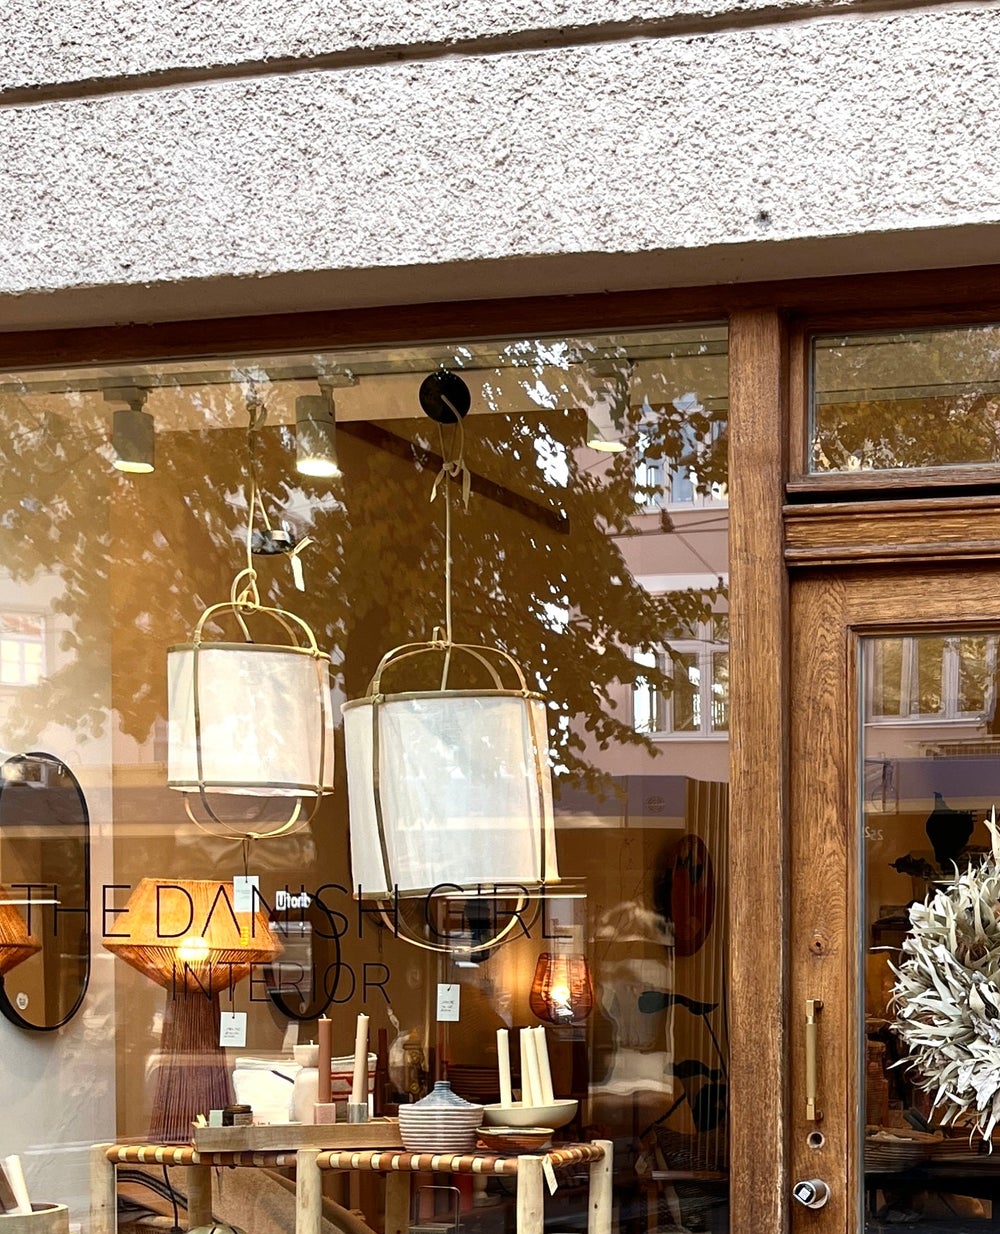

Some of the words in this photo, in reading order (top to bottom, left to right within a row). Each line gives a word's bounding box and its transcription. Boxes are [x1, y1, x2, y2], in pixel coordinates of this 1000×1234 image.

[11, 884, 131, 938] THE
[156, 883, 398, 939] DANISH
[425, 883, 572, 940] GIRL
[172, 961, 391, 1004] INTERIOR
